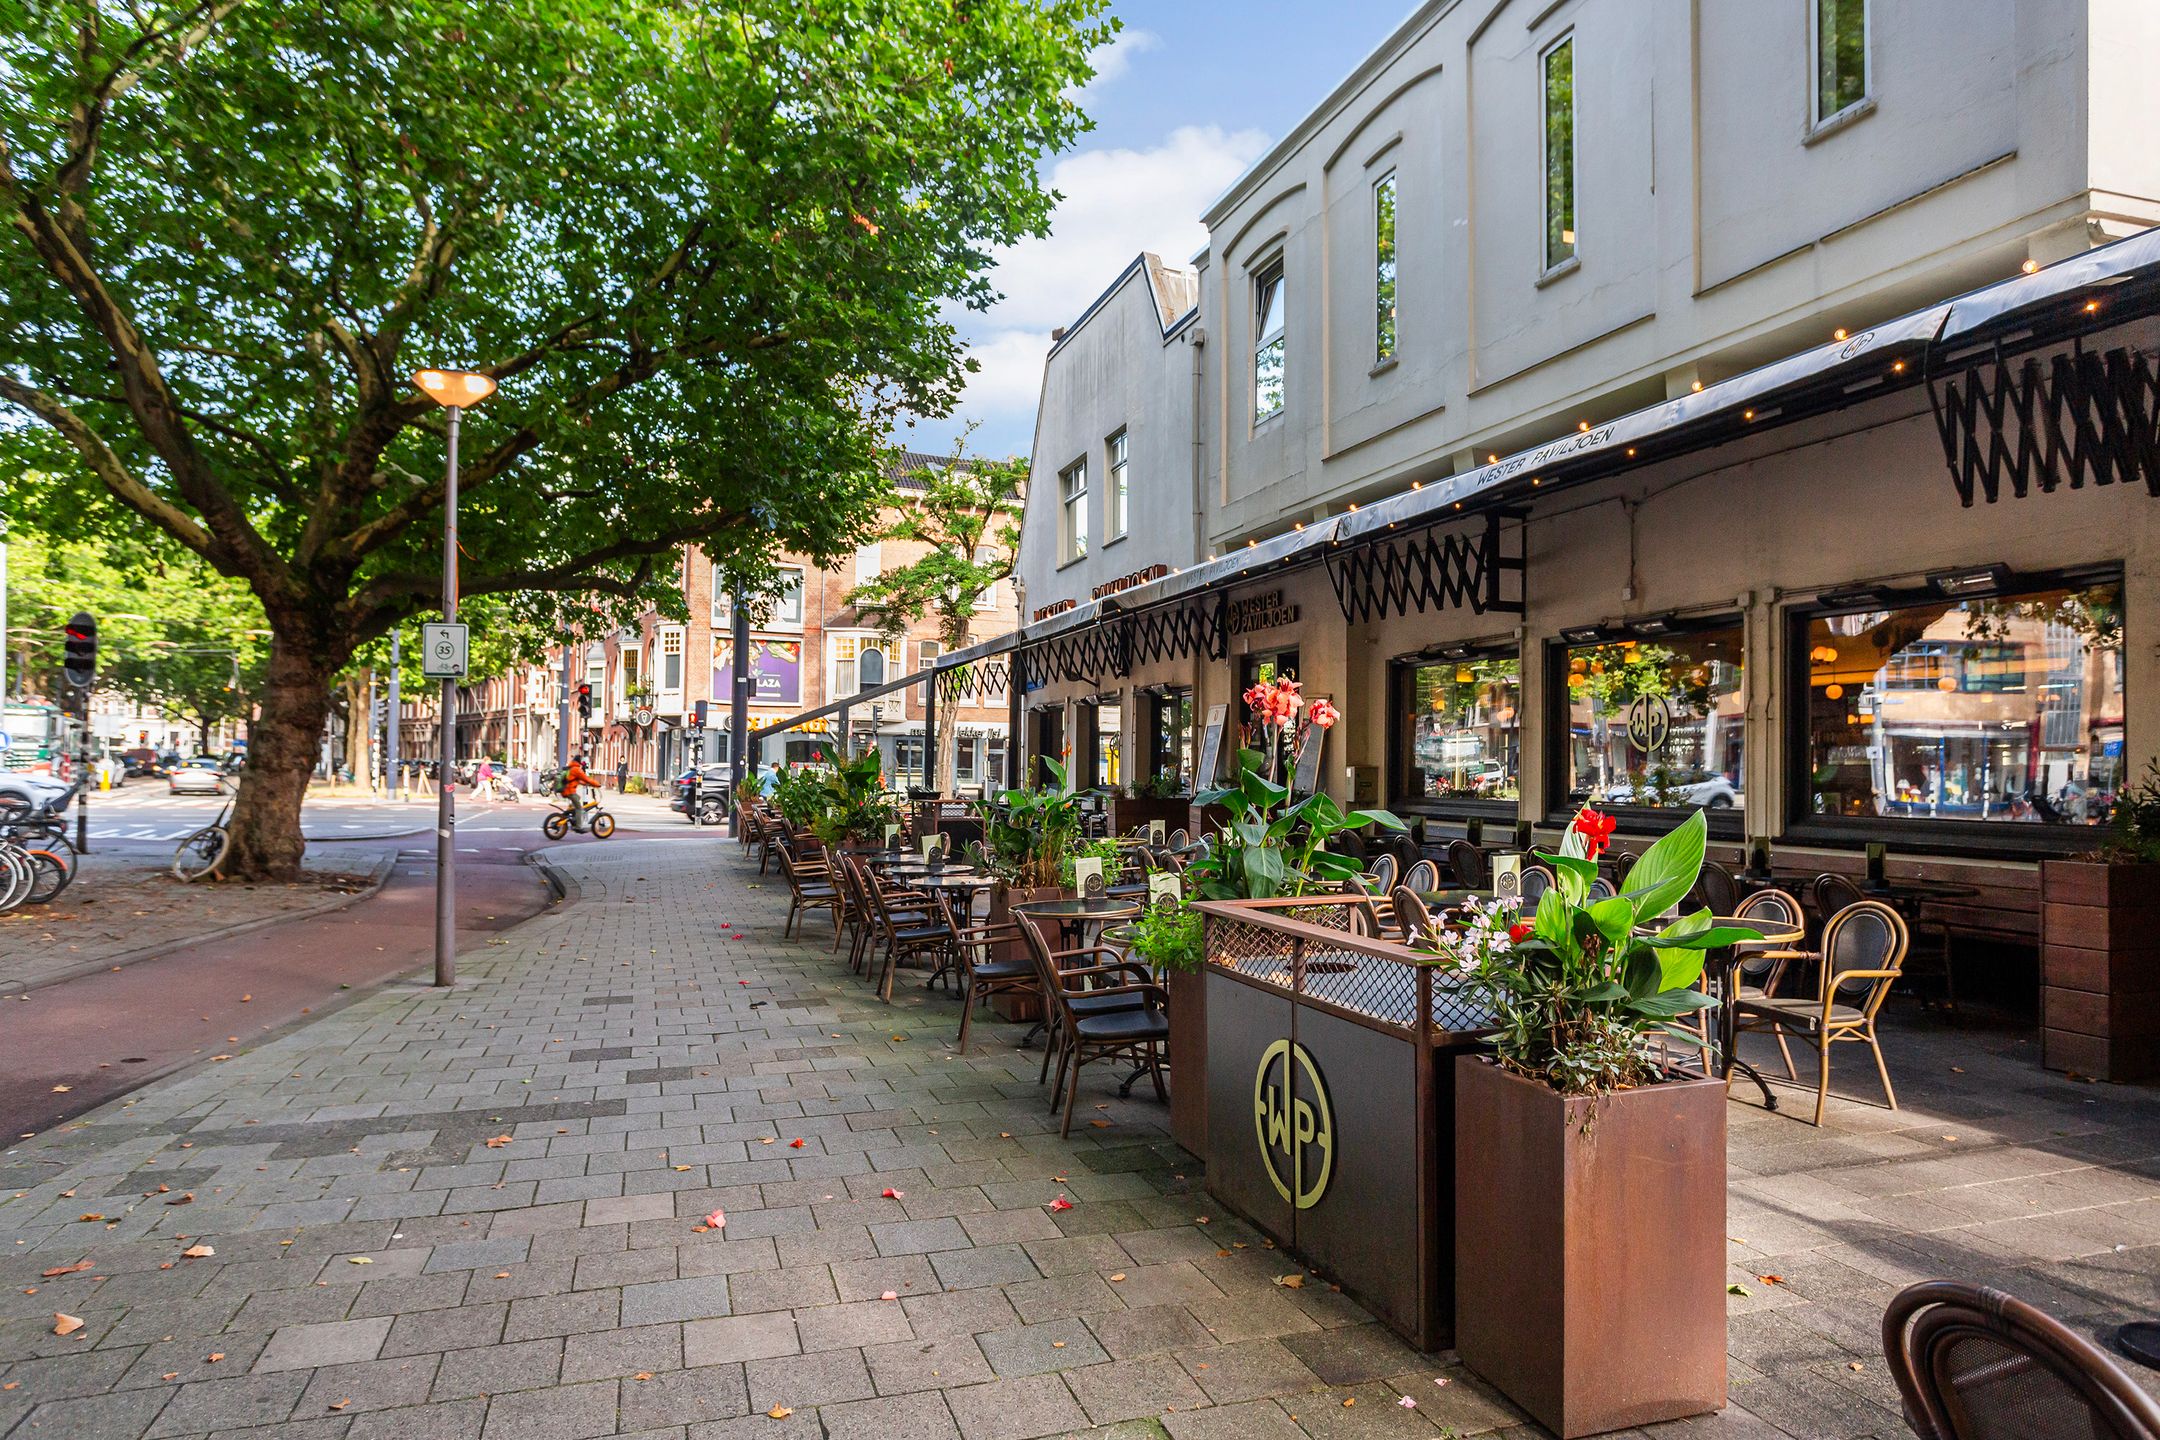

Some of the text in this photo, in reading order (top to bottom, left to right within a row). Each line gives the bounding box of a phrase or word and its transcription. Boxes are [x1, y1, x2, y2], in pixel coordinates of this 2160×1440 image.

[1476, 426, 1615, 487] WESTER PAVILJOEN
[1242, 591, 1279, 614] WESTER
[1242, 605, 1295, 632] PAVILJOEN
[438, 646, 451, 655] 35
[756, 678, 781, 688] LAZA
